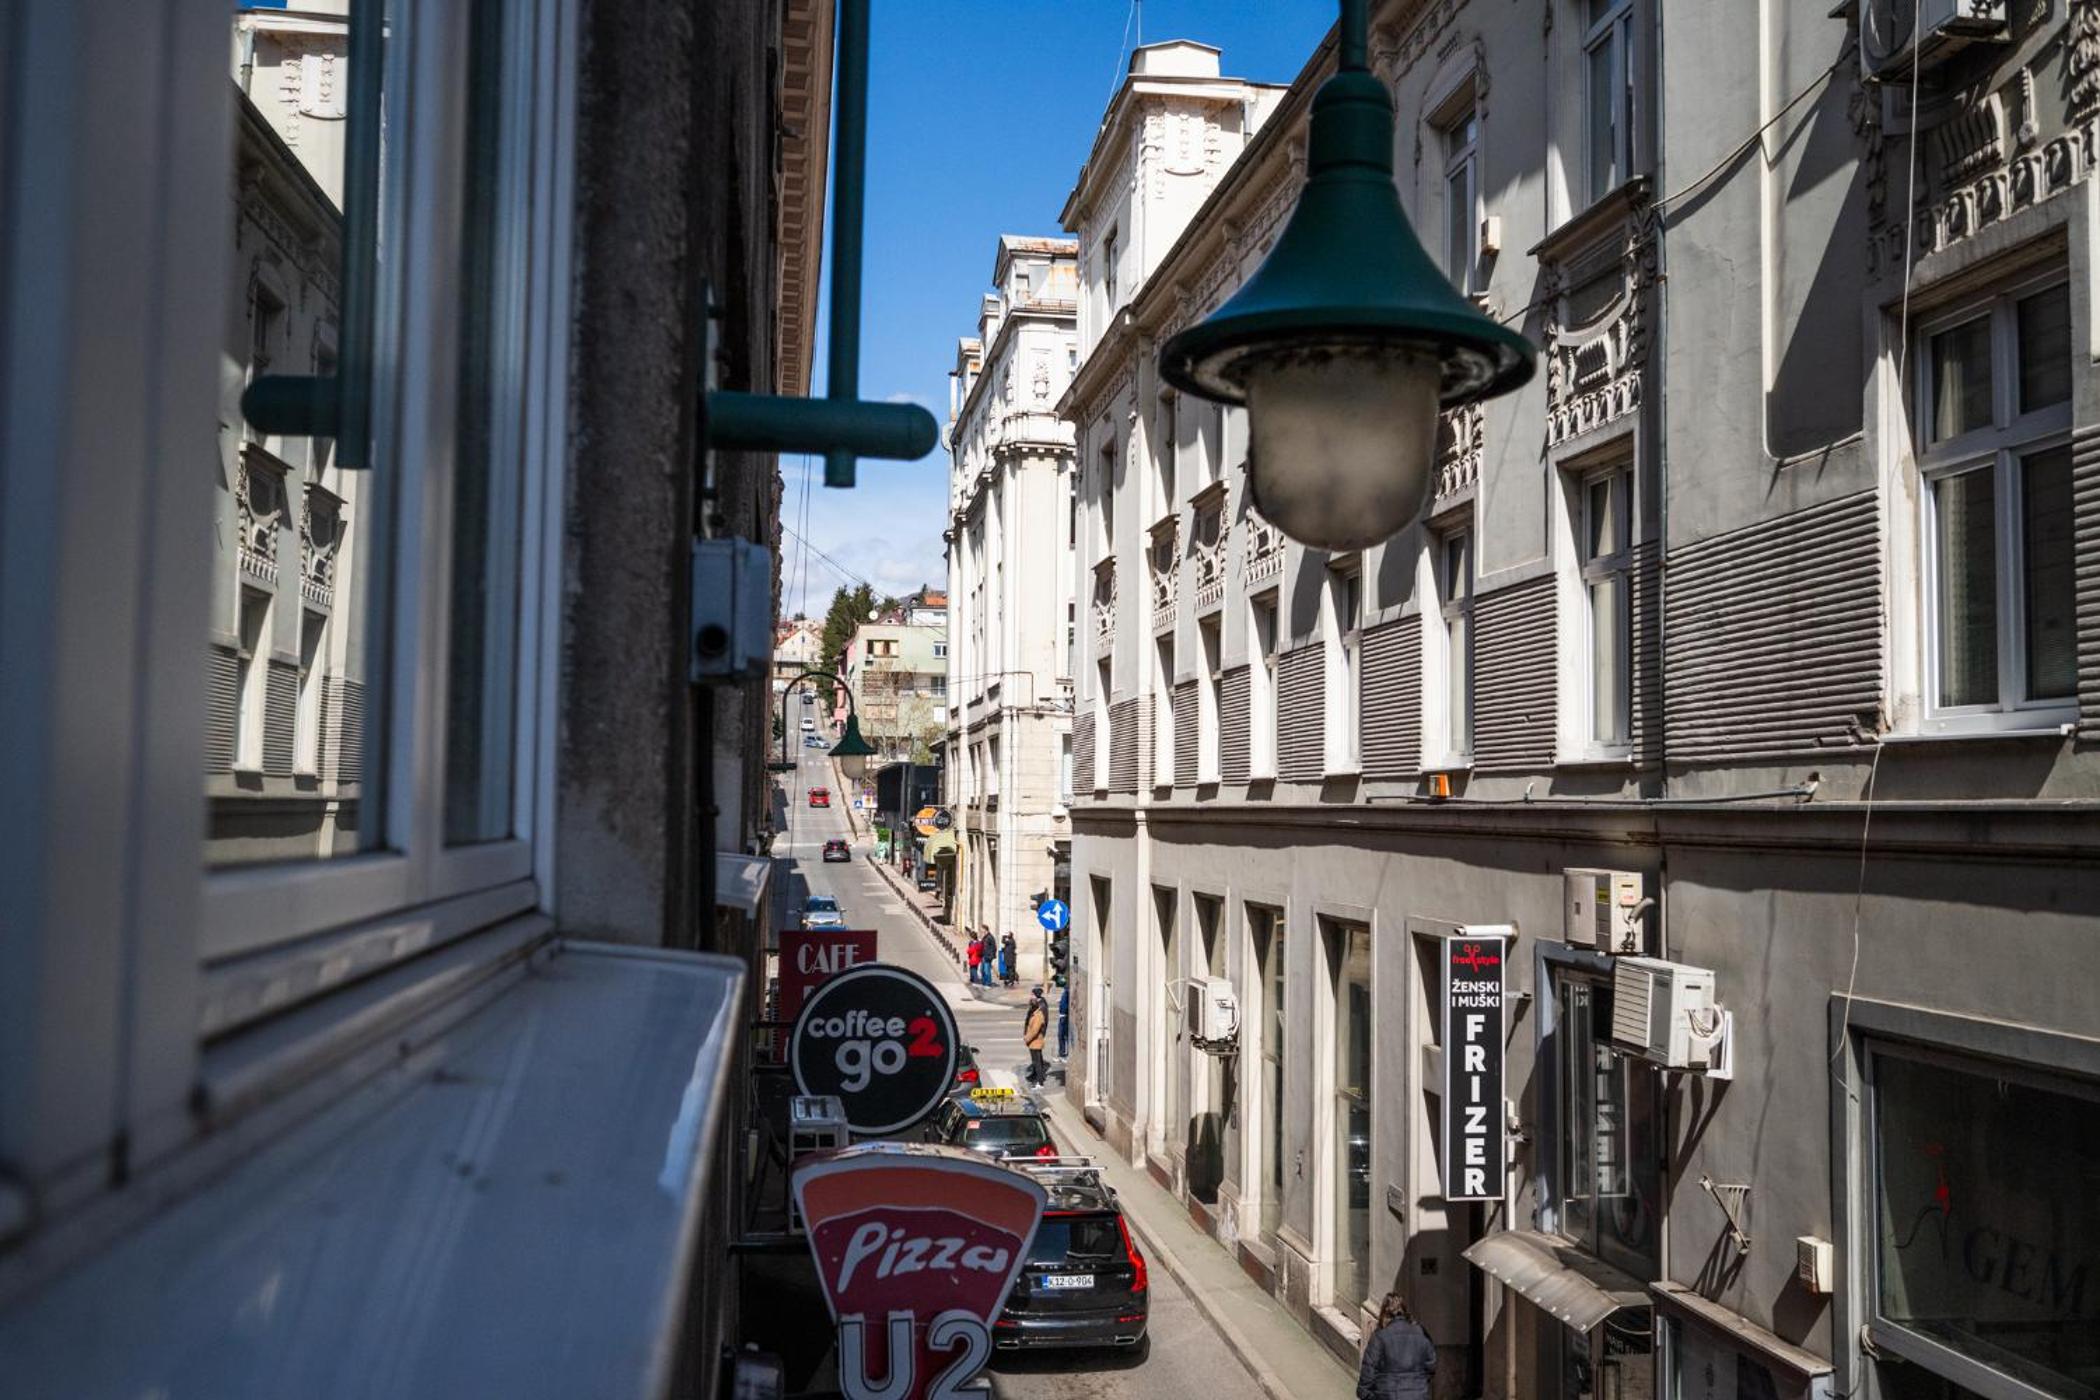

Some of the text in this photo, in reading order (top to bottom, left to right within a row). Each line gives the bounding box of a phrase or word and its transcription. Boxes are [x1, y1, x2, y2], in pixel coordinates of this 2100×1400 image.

[797, 943, 861, 975] CAFE
[1451, 994, 1499, 1008] I MUŠKI
[1452, 978, 1499, 993] ŽENSKI
[807, 1010, 943, 1057] coffee 2
[835, 1039, 907, 1093] go
[1464, 1014, 1487, 1196] FRIZER
[836, 1221, 1009, 1294] Pizza
[838, 1309, 993, 1400] U2
